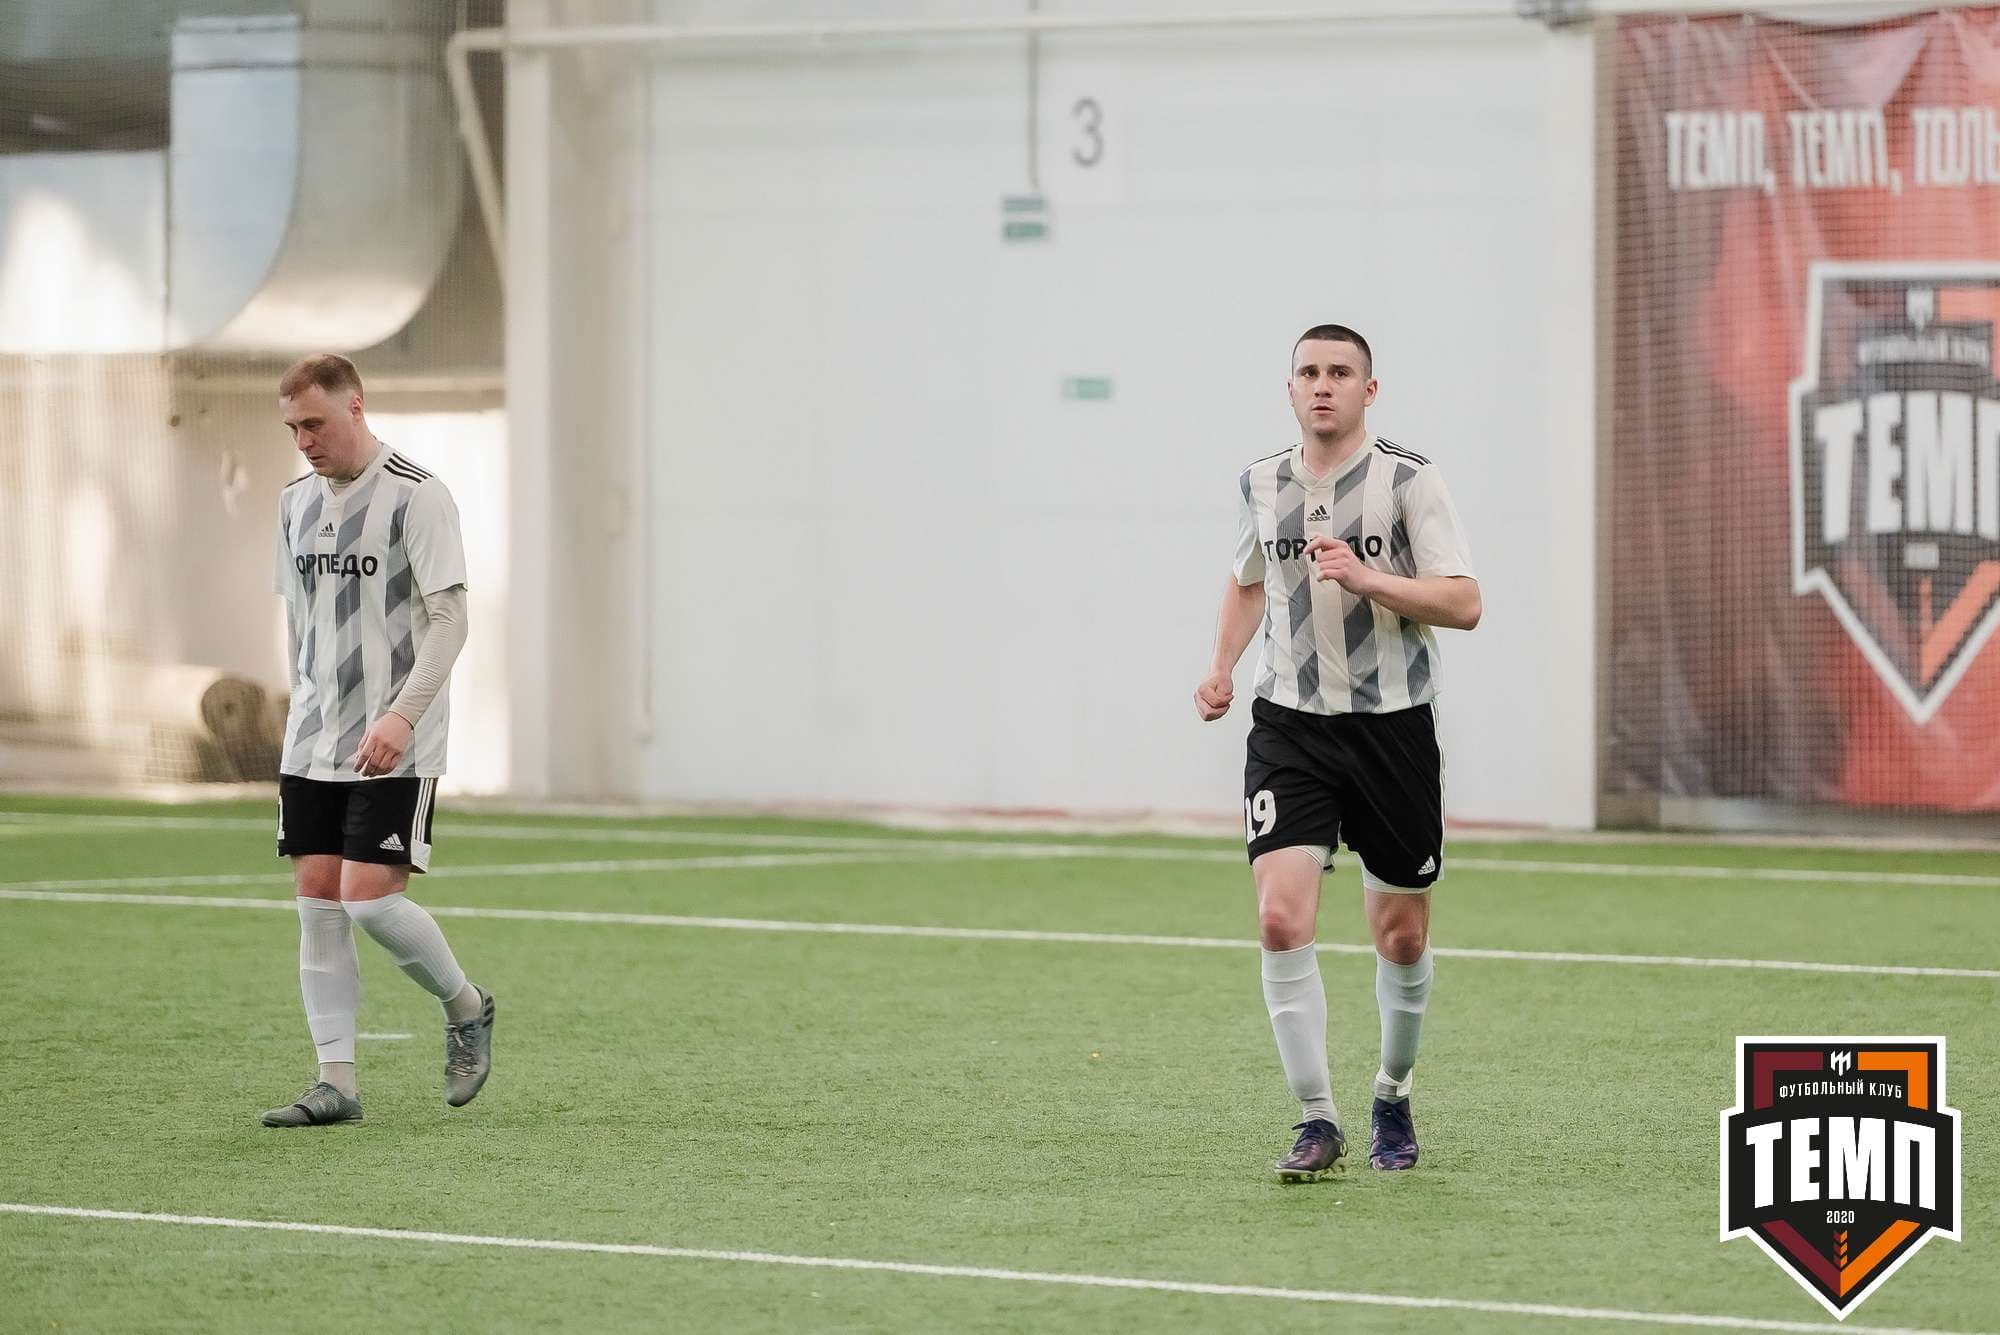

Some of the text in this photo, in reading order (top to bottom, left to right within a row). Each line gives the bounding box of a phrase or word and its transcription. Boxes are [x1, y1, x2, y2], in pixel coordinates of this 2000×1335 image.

[1071, 97, 1103, 168] 3
[1665, 110, 1777, 196] ТЕМП,
[1787, 109, 1901, 197] ТЕМП,
[1245, 789, 1276, 845] 19
